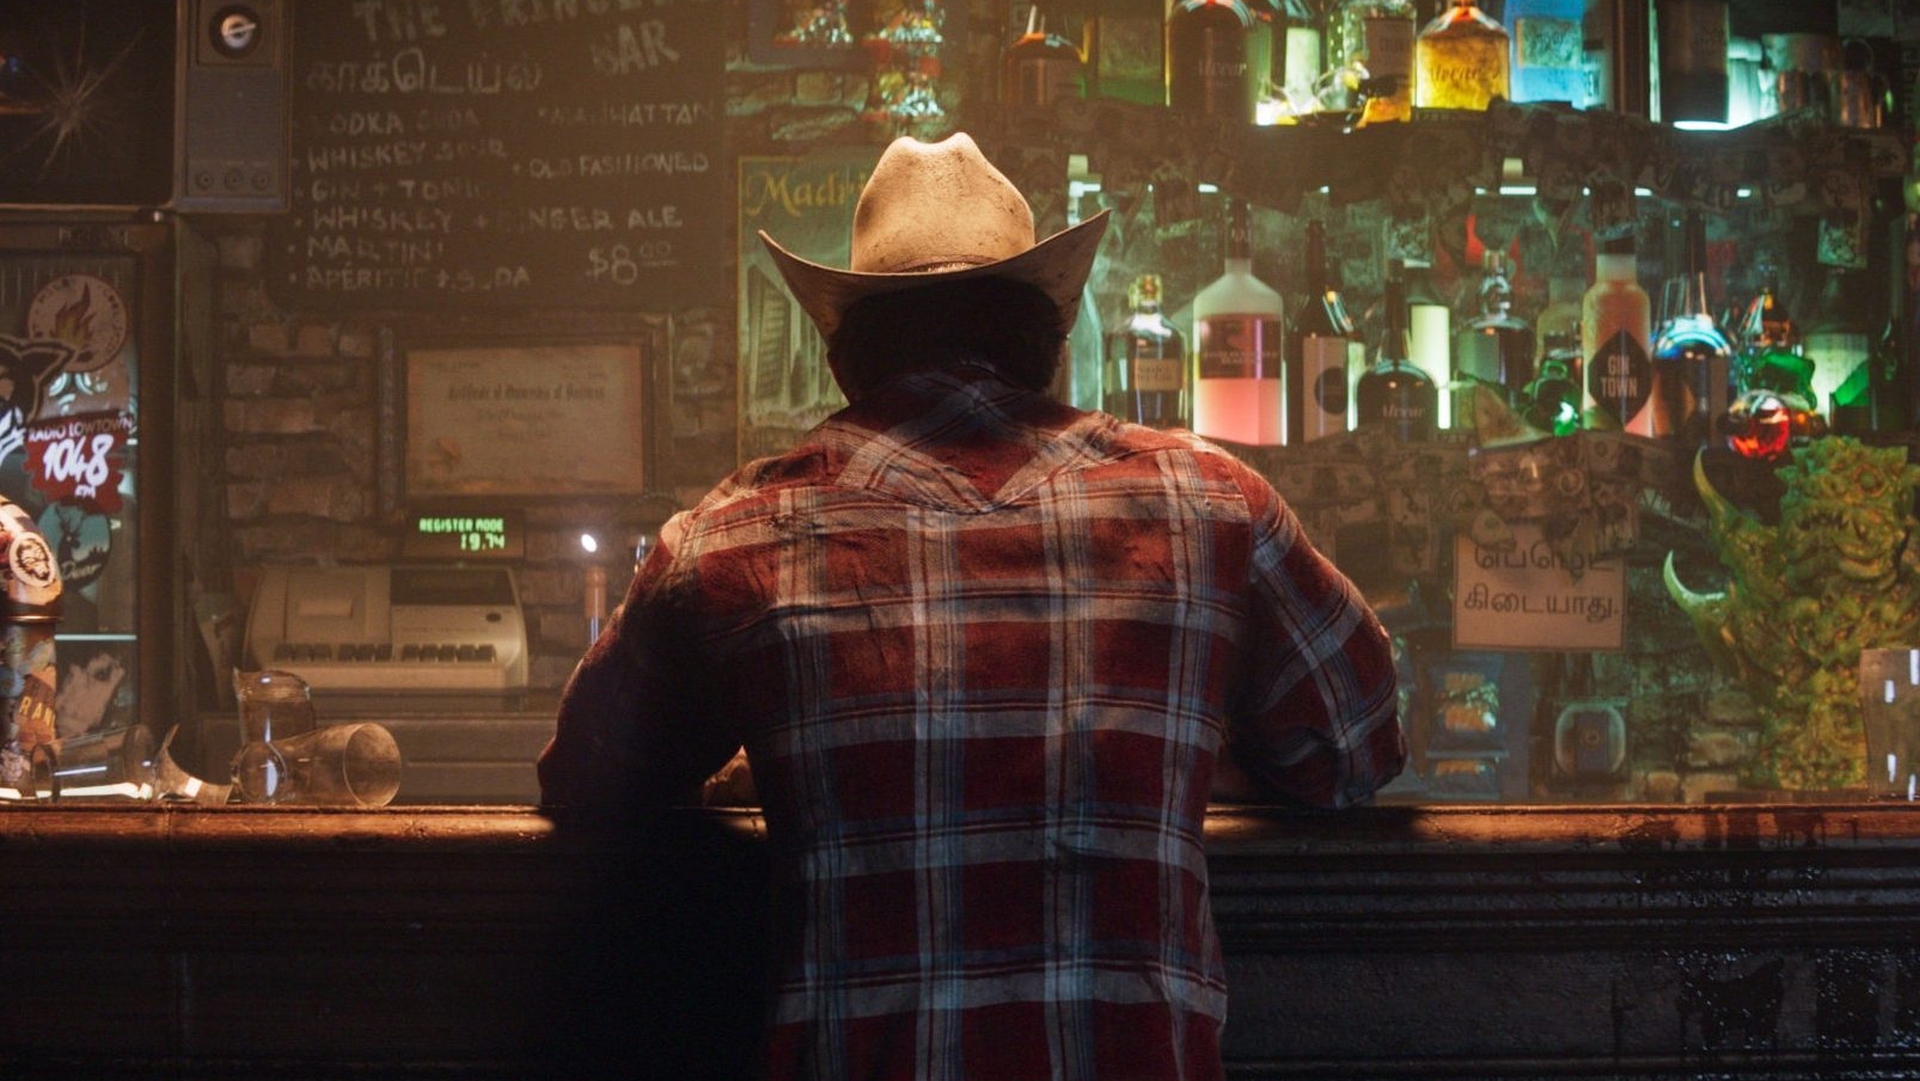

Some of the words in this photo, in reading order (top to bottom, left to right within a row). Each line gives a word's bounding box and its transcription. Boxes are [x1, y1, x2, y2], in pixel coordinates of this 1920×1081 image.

[352, 0, 447, 43] THE
[313, 110, 405, 136] ODKA
[416, 107, 481, 132] SDA
[308, 139, 428, 173] WHISKEY
[529, 157, 572, 180] OLD
[580, 151, 710, 178] FASHIONED
[512, 206, 616, 232] NGER
[628, 204, 684, 231] ALE
[457, 263, 532, 294] SDA
[1606, 353, 1632, 376] GIN
[1600, 377, 1639, 398] TOWN
[28, 423, 67, 443] RADIO
[419, 518, 473, 533] REGISTER
